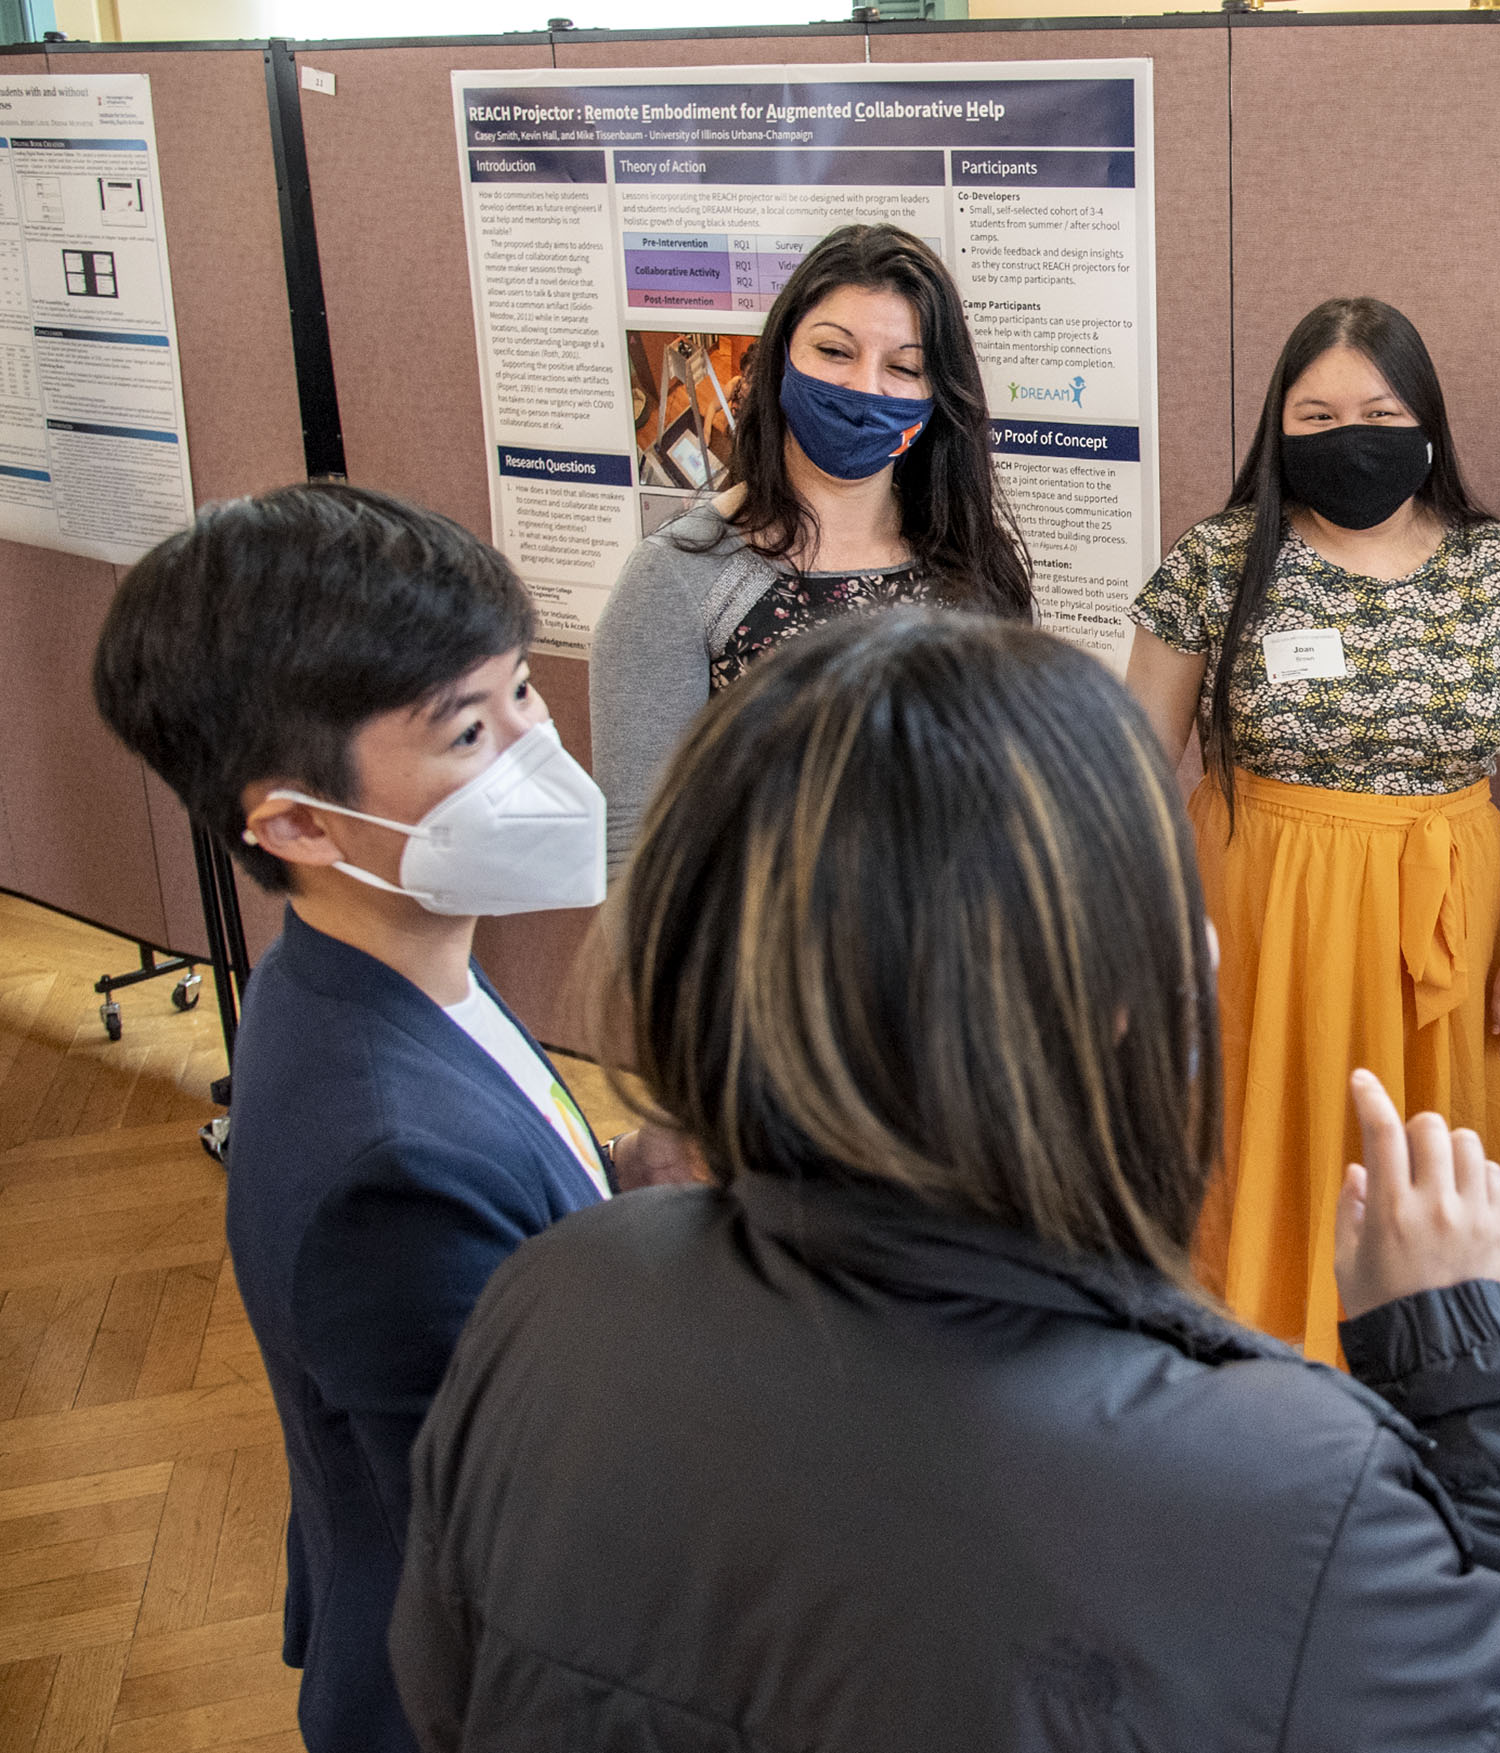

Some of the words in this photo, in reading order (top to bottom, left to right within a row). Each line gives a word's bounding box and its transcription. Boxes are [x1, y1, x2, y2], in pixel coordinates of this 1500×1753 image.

[58, 87, 89, 97] without
[469, 106, 510, 120] REACH
[513, 104, 574, 124] Projector
[584, 104, 638, 124] Remote
[642, 103, 737, 123] Embodiment
[740, 102, 763, 119] for
[766, 101, 851, 123] Augmented
[854, 100, 962, 122] Collaborative
[966, 100, 1004, 121] Help
[474, 131, 496, 142] Casey
[521, 131, 541, 140] Kevin
[561, 130, 575, 140] and
[576, 130, 594, 140] Mike
[595, 130, 643, 140] Tissenbaum
[649, 128, 690, 143] University
[690, 129, 699, 140] of
[701, 129, 729, 140] Illinois
[731, 128, 813, 144] Urbana-Champaign
[476, 159, 535, 172] Introduction
[619, 160, 657, 176] Theory
[659, 159, 670, 172] of
[672, 160, 705, 173] Action
[962, 160, 1037, 177] Participants
[493, 191, 502, 199] do
[545, 191, 559, 201] help
[560, 192, 589, 200] students
[958, 191, 1020, 202] Co-Developers
[969, 205, 995, 215] Small,
[996, 205, 1048, 215] self-selected
[1050, 206, 1078, 216] cohort
[1079, 206, 1088, 215] of
[1090, 207, 1103, 216] 3-4
[969, 219, 1005, 228] students
[1006, 219, 1026, 228] from
[1070, 220, 1090, 230] after
[1092, 221, 1119, 230] school
[642, 238, 708, 248] Pre-Intervention
[970, 234, 999, 243] camps.
[734, 240, 750, 250] RQ1
[776, 241, 803, 252] Survey
[971, 246, 1002, 255] Provide
[1004, 246, 1041, 256] feedback
[1043, 248, 1059, 257] and
[1060, 248, 1088, 260] design
[1090, 248, 1123, 260] insights
[736, 261, 751, 271] RQ1
[635, 266, 688, 276] Collaborative
[689, 267, 720, 279] Activity
[737, 277, 753, 287] RQ2
[644, 295, 714, 306] Post-Intervention
[738, 298, 753, 308] RQ1
[963, 300, 986, 311] Camp
[989, 300, 1040, 311] Participants
[1021, 389, 1070, 401] DREAAM
[1005, 429, 1037, 443] Proof
[1040, 431, 1052, 444] of
[1055, 432, 1107, 451] Concept
[505, 454, 545, 470] Research
[546, 458, 596, 474] Questions
